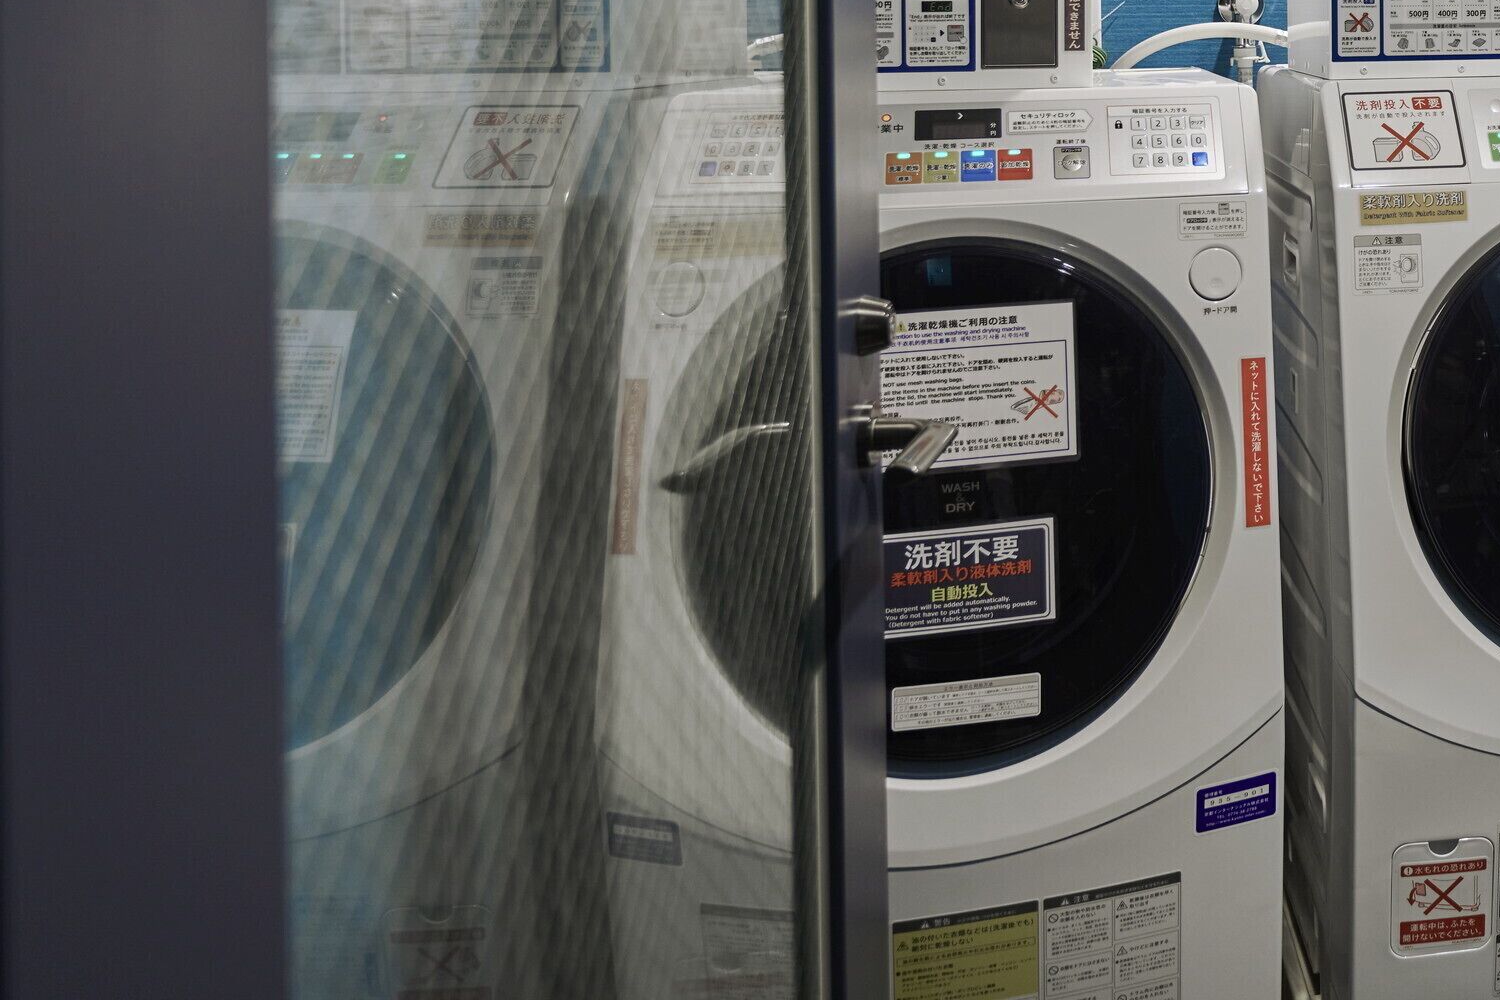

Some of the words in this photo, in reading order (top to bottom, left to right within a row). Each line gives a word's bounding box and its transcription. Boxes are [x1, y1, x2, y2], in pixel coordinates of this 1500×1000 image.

[1408, 10, 1429, 18] 500円
[1437, 10, 1458, 18] 400円
[1355, 99, 1410, 111] 洗剤投入
[1413, 97, 1440, 109] 不要
[1355, 111, 1446, 119] 洗剤が自動で投入されます
[878, 124, 904, 133] 業中
[1175, 119, 1180, 127] 3
[1363, 191, 1465, 210] 柔軟剤入り洗剤
[1385, 236, 1404, 244] 注意
[908, 315, 1018, 331] 洗濯乾燥機ご利用の注意
[1249, 360, 1264, 523] ネットに入れて洗濯しないで下さい
[942, 481, 980, 493] WASH
[945, 502, 975, 513] DRY
[905, 535, 1019, 570] 洗剤不要
[890, 559, 1032, 588] 柔軟剤入り液体洗剤
[931, 583, 994, 602] 自動投入
[885, 606, 918, 614] Detergent
[965, 596, 1011, 606] automatically.
[983, 603, 1011, 611] washing
[1012, 600, 1038, 608] powder.
[888, 620, 925, 628] (Detergent
[963, 612, 994, 620] softener)
[1414, 861, 1484, 874] 水もれの恐れあり
